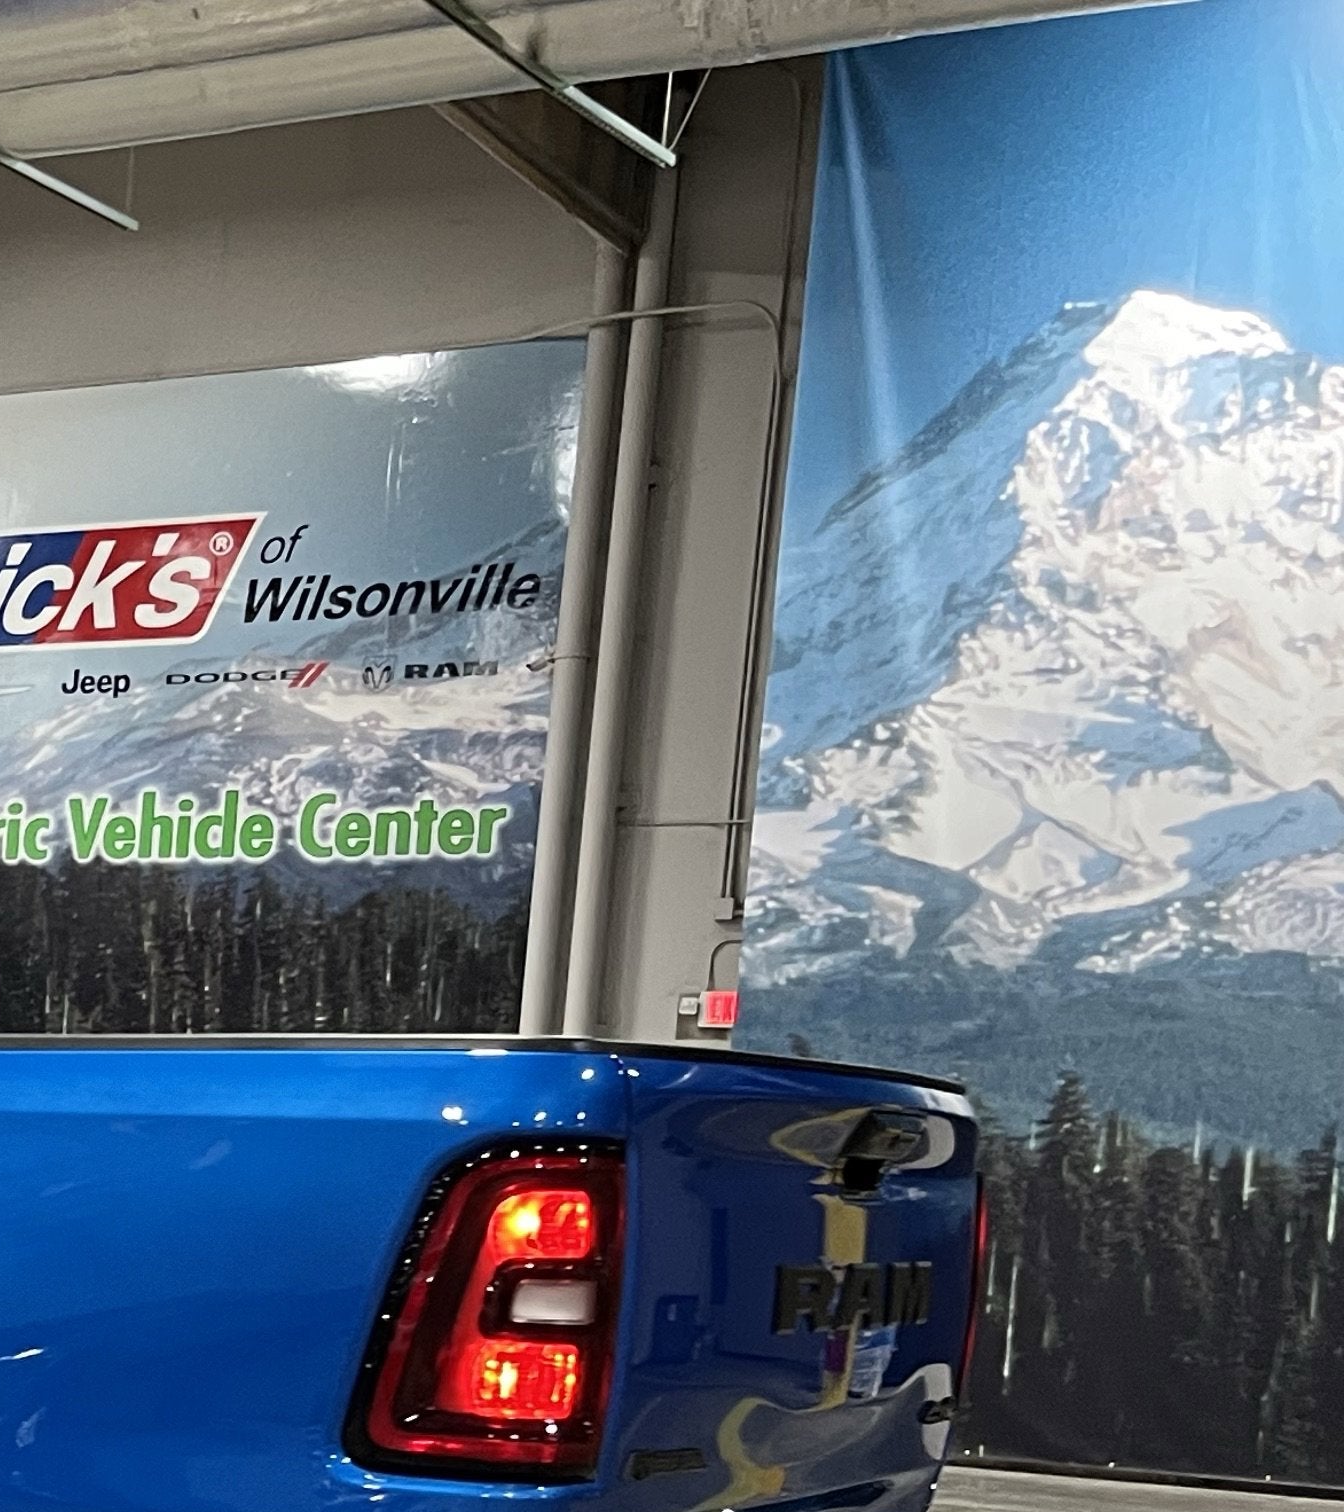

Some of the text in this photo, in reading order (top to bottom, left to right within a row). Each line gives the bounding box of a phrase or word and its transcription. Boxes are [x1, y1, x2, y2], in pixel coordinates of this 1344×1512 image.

[260, 524, 310, 564] of
[244, 562, 541, 624] Wilsonville
[61, 668, 131, 698] Jeep
[164, 672, 302, 686] DODGE
[403, 660, 500, 682] RAM
[69, 792, 275, 860] Vehicle
[299, 792, 508, 858] Center
[771, 1260, 933, 1335] RAM
